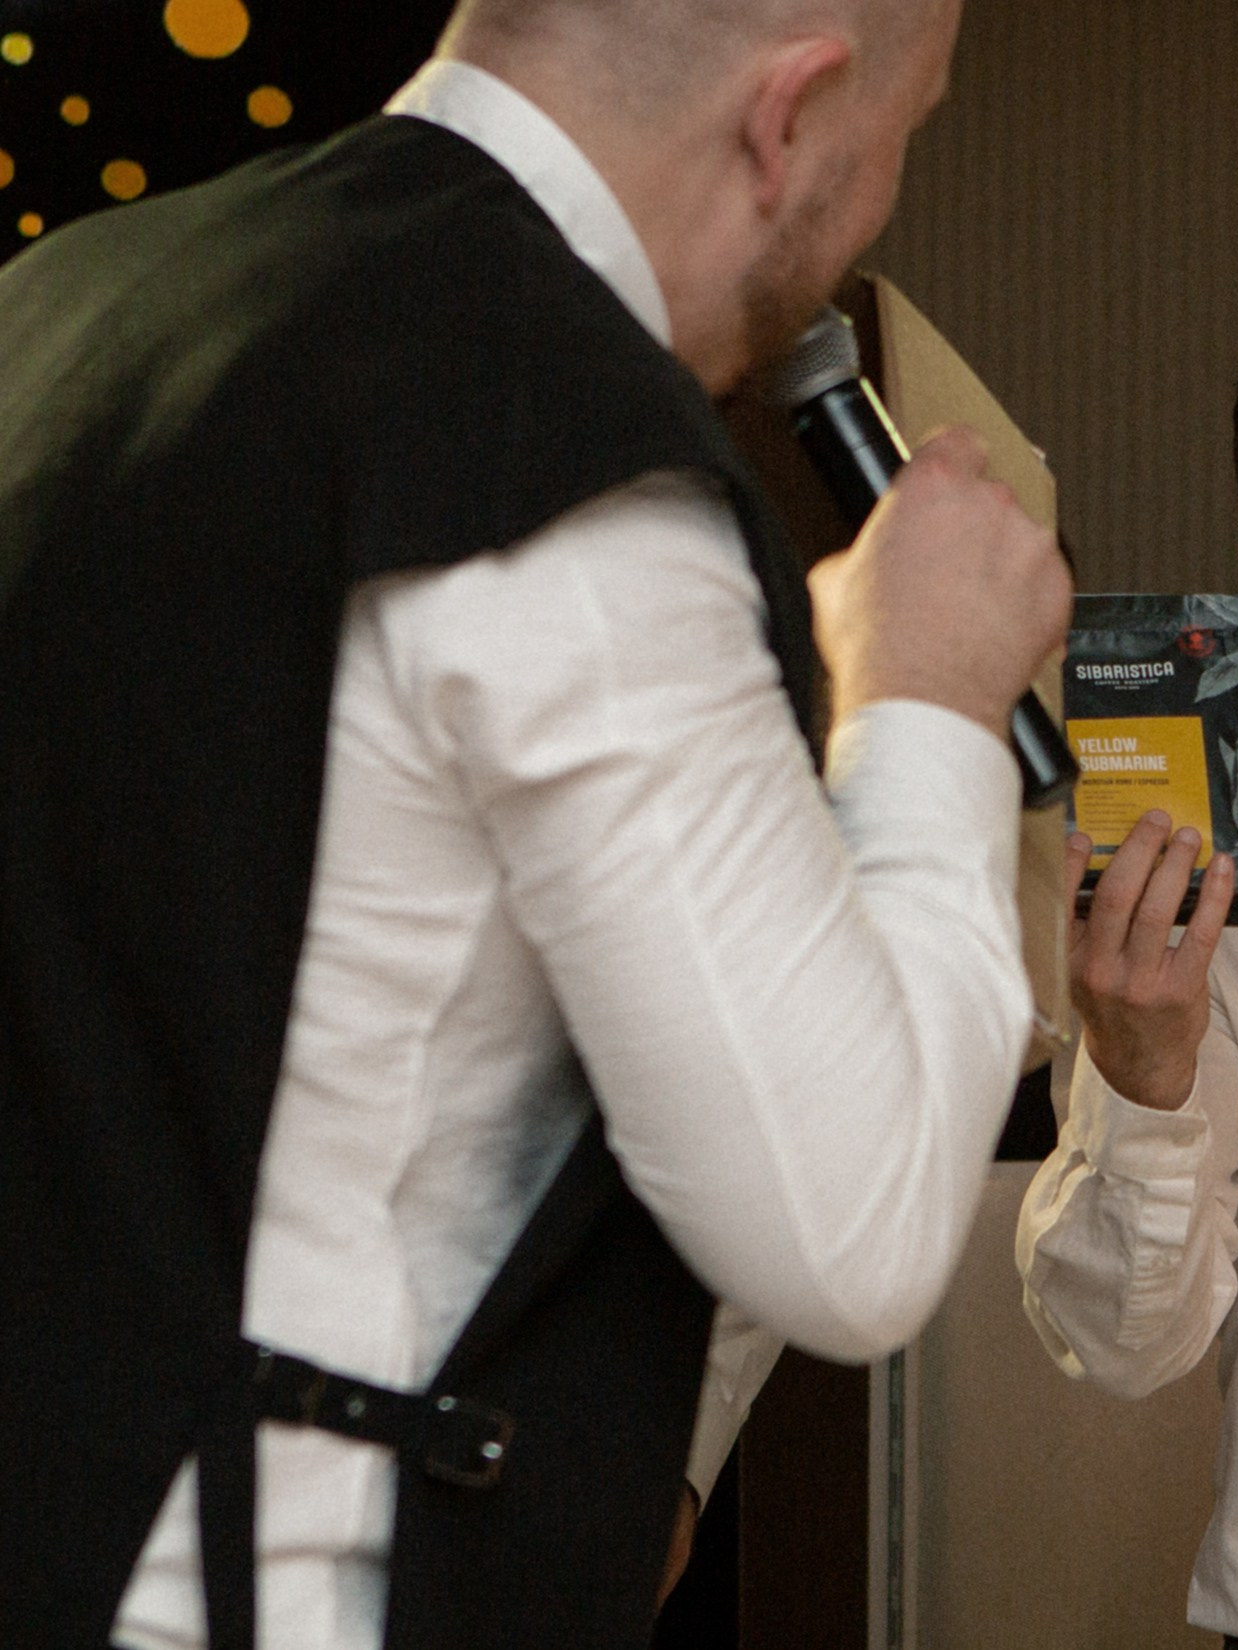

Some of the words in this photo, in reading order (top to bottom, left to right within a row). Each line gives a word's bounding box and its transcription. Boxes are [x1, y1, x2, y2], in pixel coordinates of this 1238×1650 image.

[1076, 661, 1175, 679] SIBARISTICA
[1078, 738, 1137, 753] YELLOW
[1079, 755, 1168, 771] SUBMARINE
